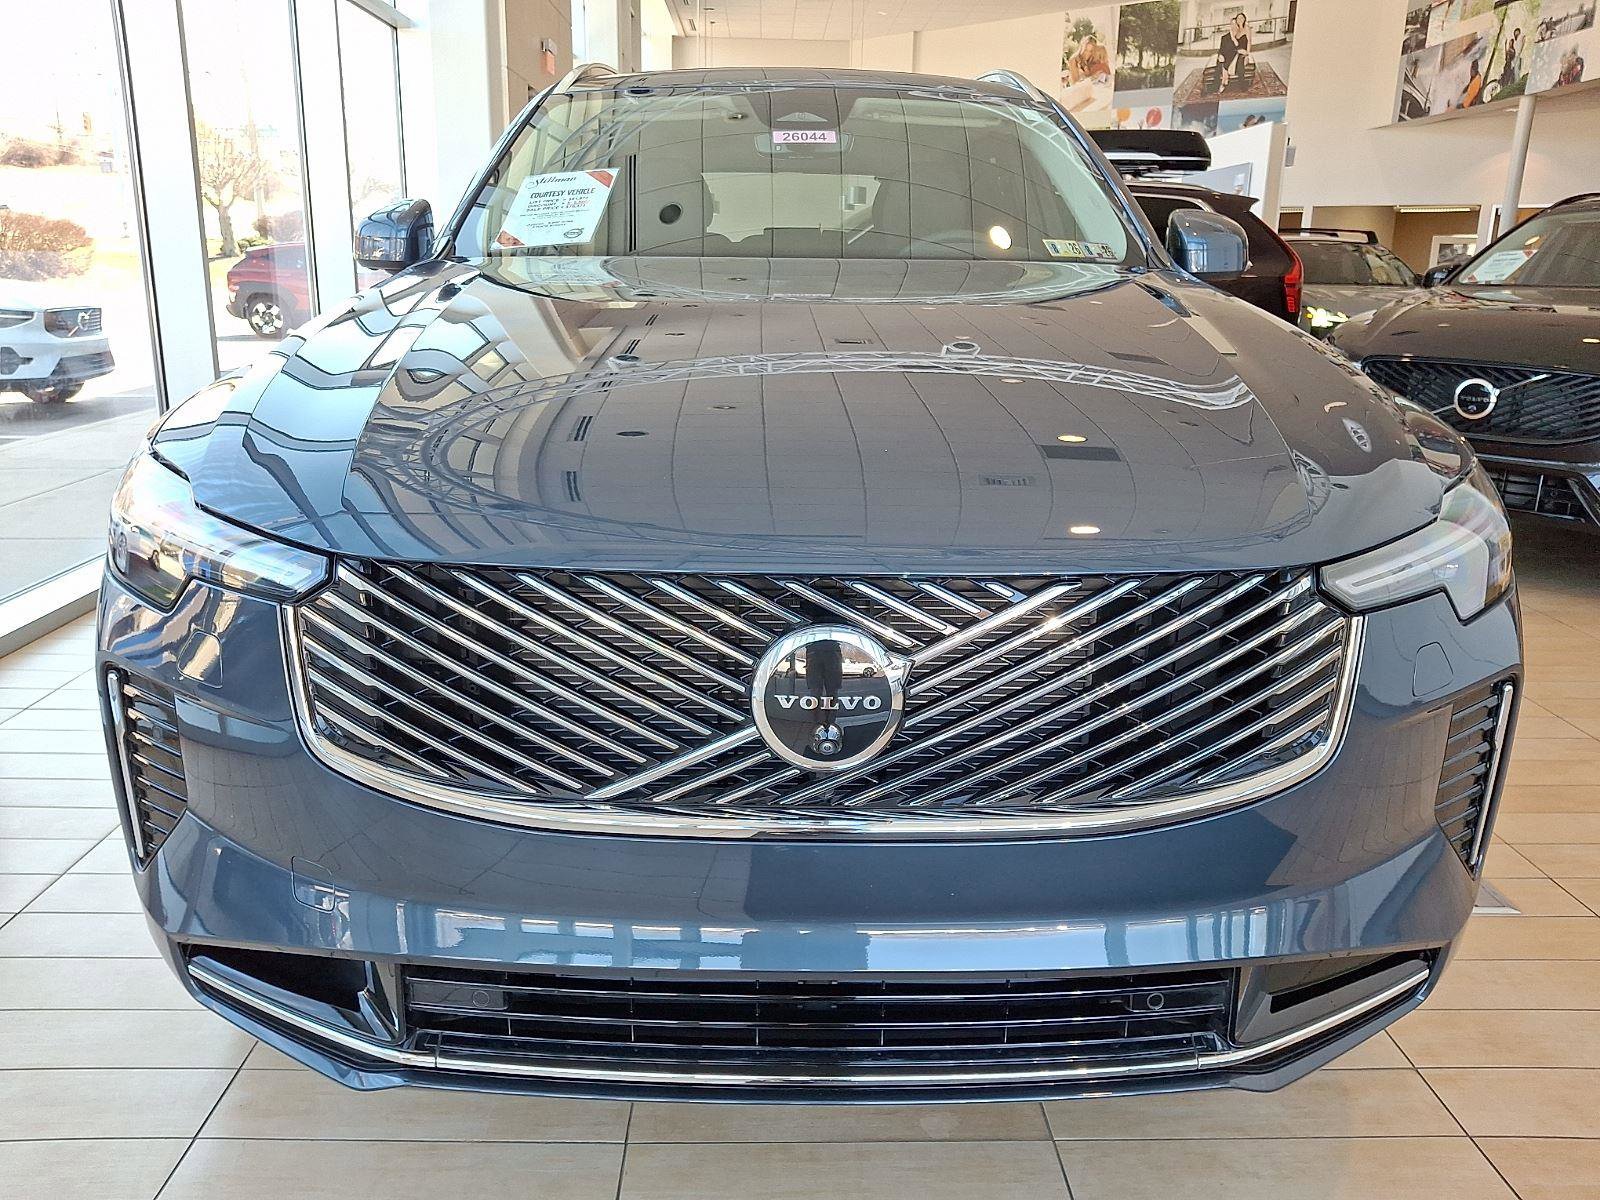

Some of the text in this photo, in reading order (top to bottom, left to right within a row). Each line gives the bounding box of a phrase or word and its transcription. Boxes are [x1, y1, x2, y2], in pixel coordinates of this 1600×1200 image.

[782, 132, 827, 141] 26044
[530, 190, 565, 199] COURTESY
[567, 187, 596, 196] VEHICLE
[774, 694, 882, 710] VOLVO
